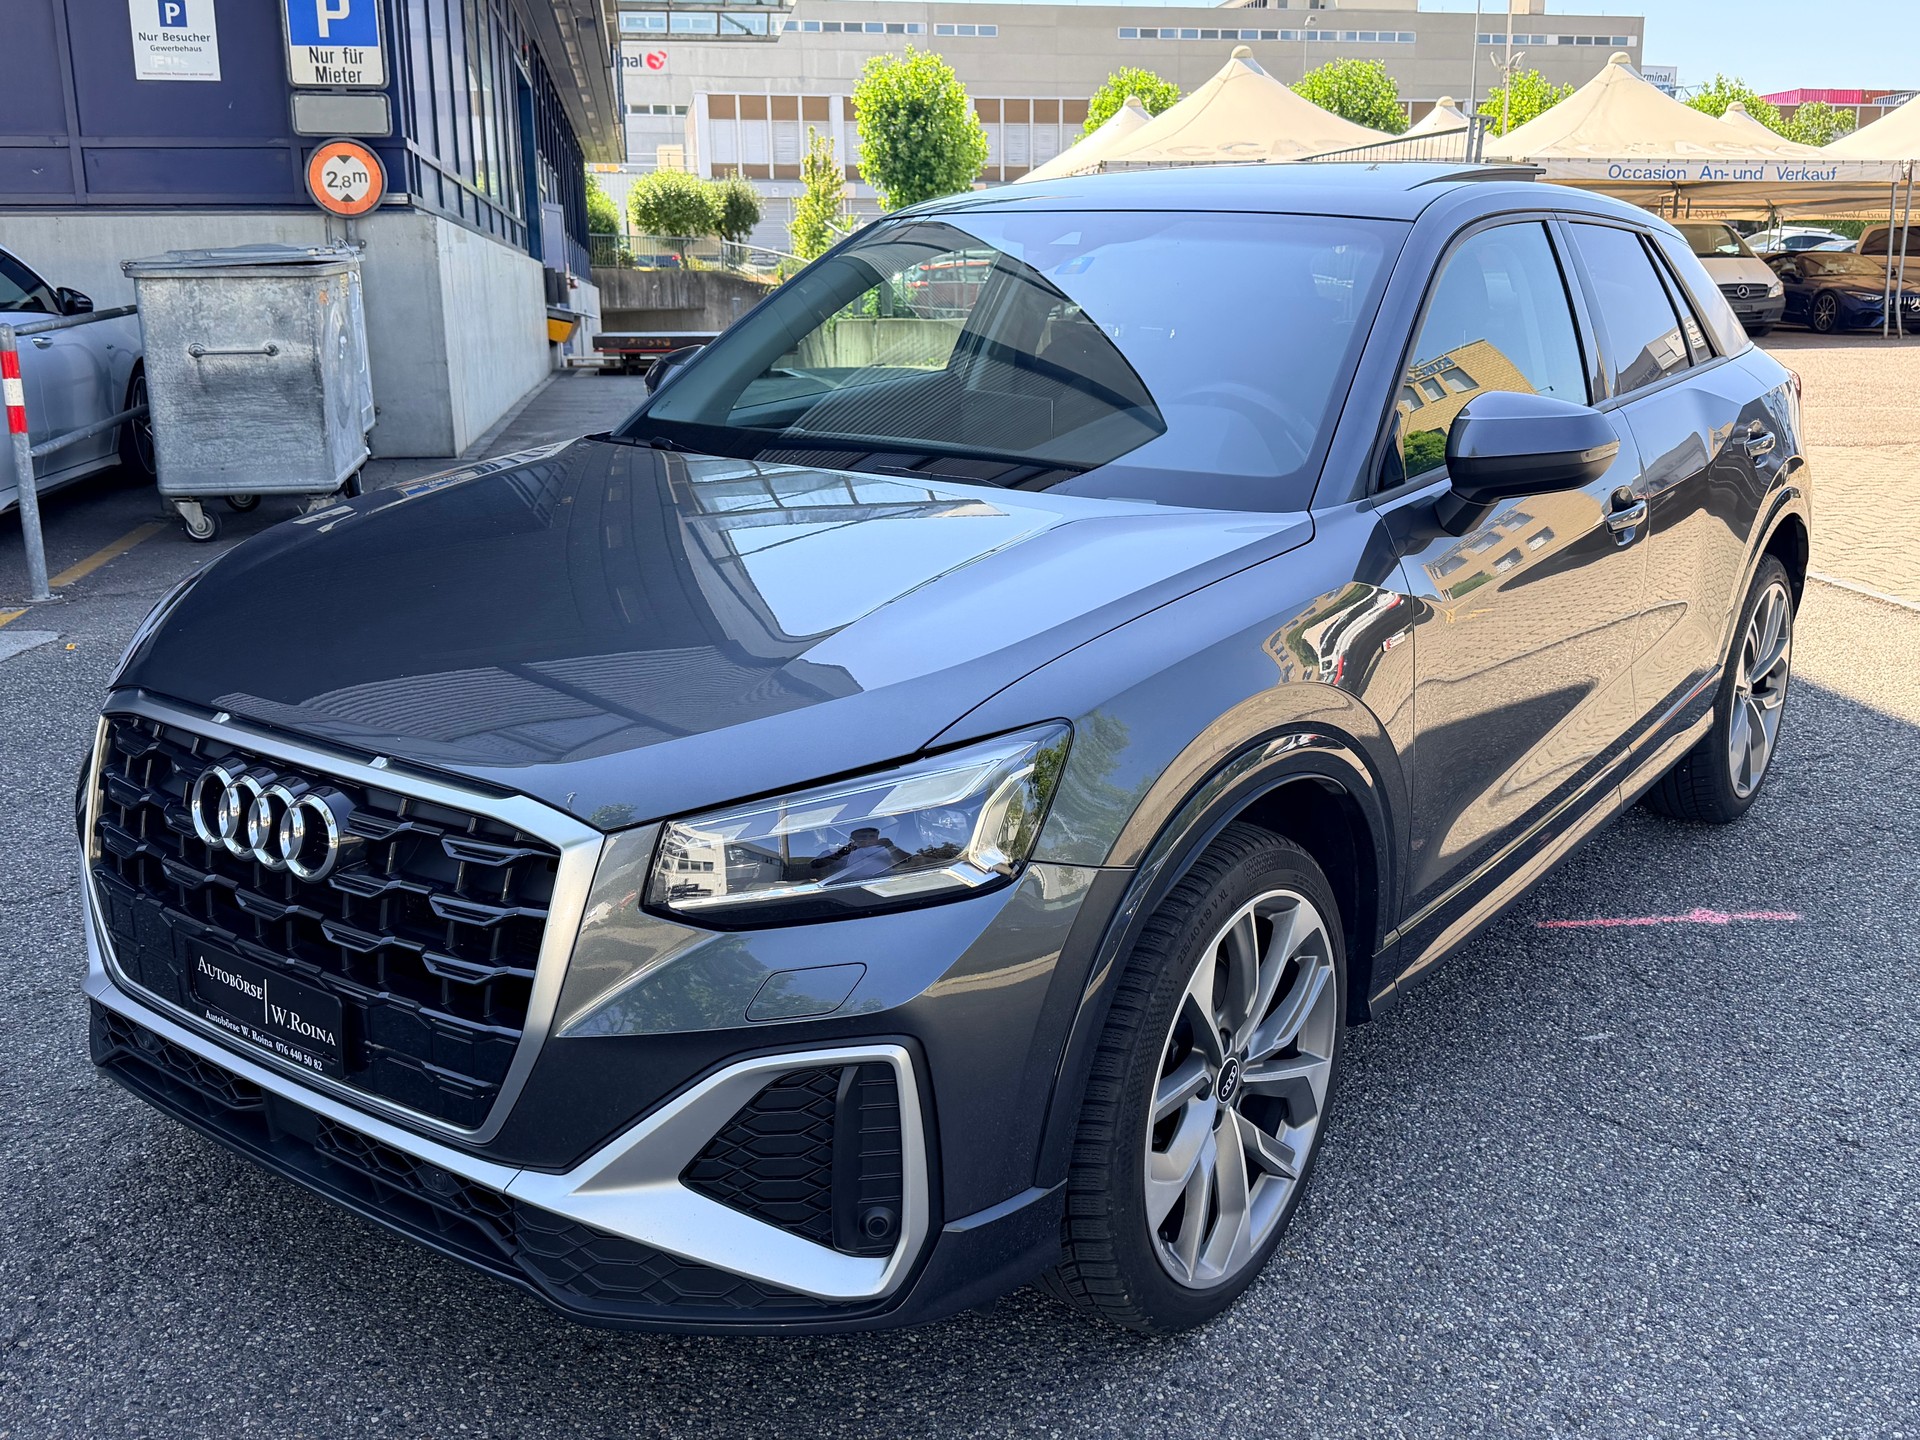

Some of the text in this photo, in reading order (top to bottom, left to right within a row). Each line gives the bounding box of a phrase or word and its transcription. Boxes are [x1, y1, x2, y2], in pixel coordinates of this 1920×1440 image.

[138, 31, 211, 43] Nur Besucher
[149, 44, 203, 53] Gewerbehaus
[308, 46, 364, 65] Nur für
[315, 65, 362, 84] Mieter
[1607, 164, 1687, 180] Occasion
[1776, 166, 1838, 181] Verkauf
[205, 1009, 323, 1072] Autobörse W. Roina 076 440 50 82
